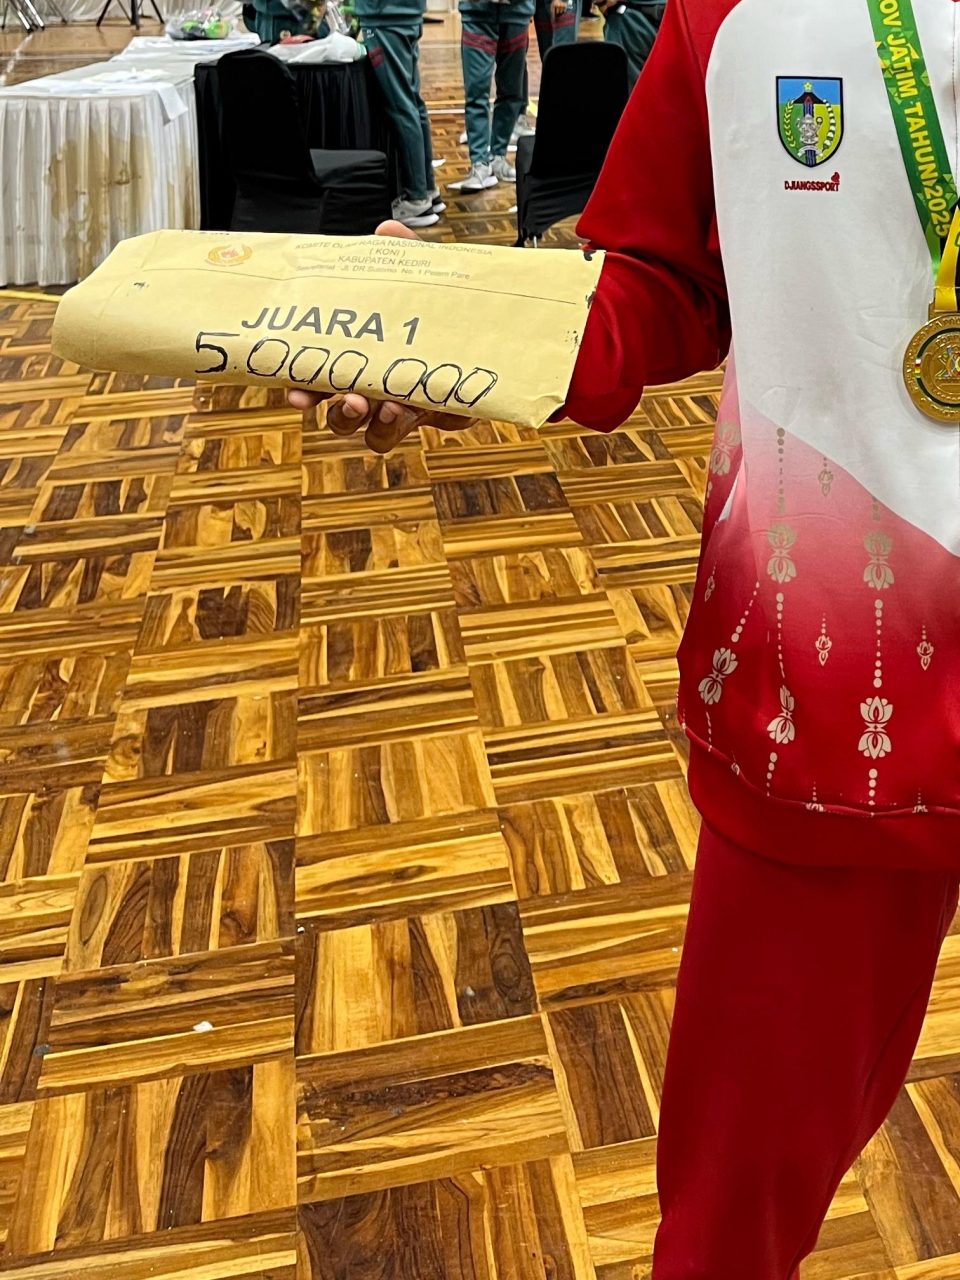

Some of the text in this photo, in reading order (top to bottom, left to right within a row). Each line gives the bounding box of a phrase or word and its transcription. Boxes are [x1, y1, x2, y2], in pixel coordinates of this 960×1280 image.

[886, 33, 918, 98] JATIM
[904, 102, 938, 181] TAHUN
[924, 184, 950, 237] 2025
[338, 255, 431, 268] KABUPATEN KEDIRI
[242, 305, 420, 345] JUARA 1
[195, 331, 498, 408] 5.000.000
